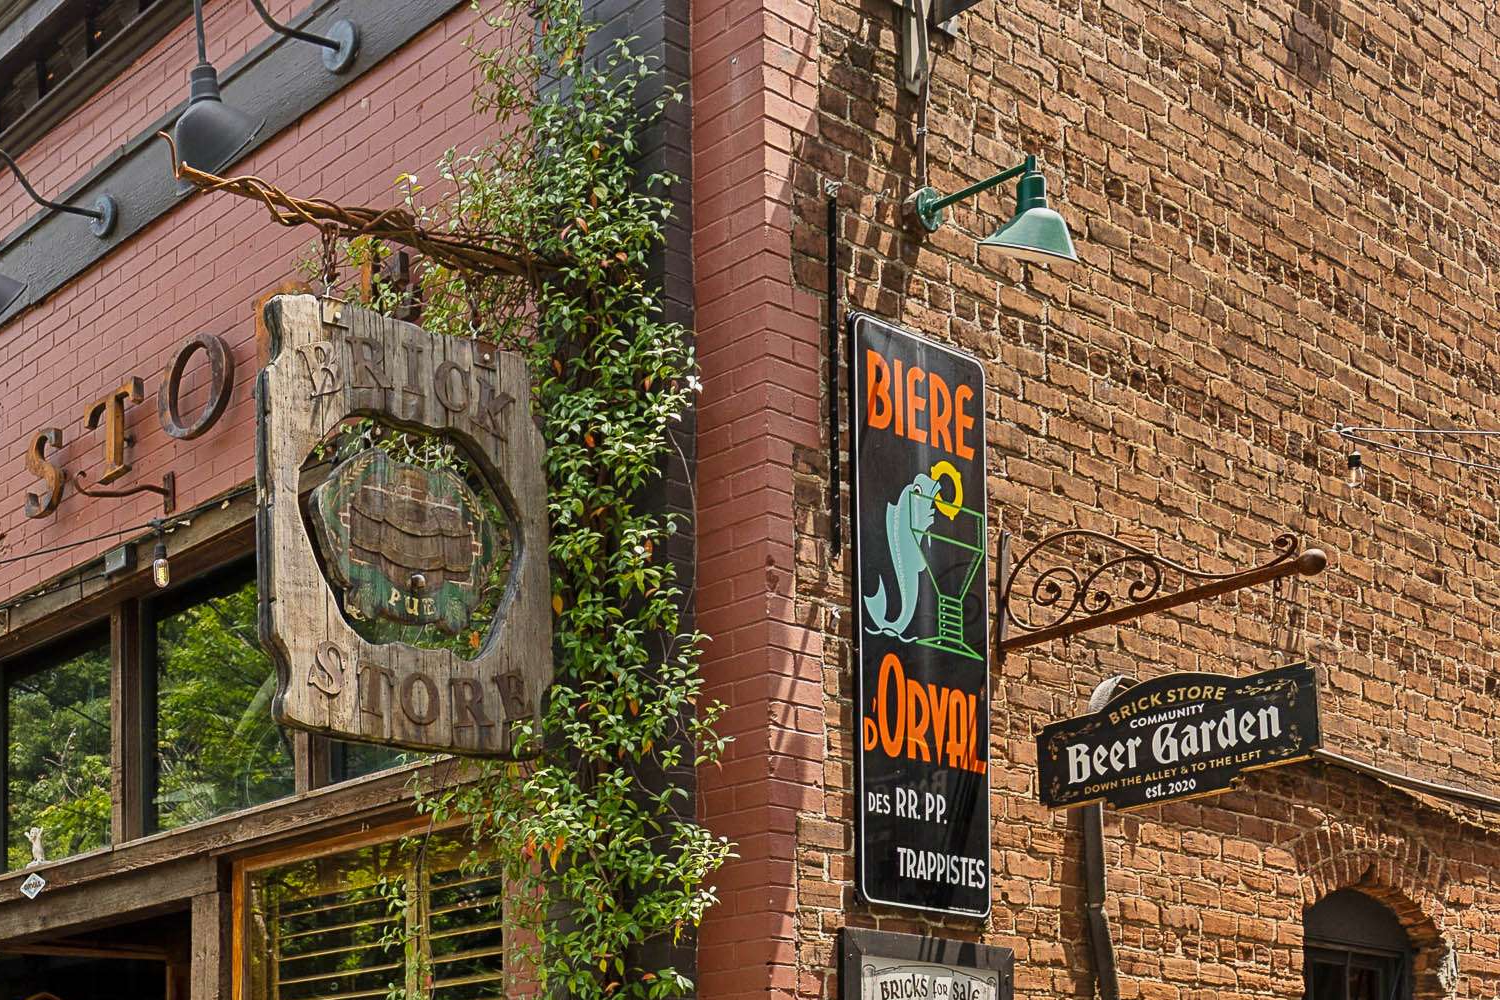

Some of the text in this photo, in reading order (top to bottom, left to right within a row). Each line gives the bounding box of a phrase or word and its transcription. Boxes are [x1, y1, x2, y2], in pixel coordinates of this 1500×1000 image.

[296, 335, 516, 443] BRICK
[867, 349, 976, 461] BIERE
[308, 640, 536, 729] STORE
[1108, 685, 1227, 726] BRICK STORE
[1129, 703, 1205, 729] COMMUNITY
[1066, 705, 1282, 785] Beer Garden
[1084, 750, 1262, 796] DOWN THE ALLEY & TO THE LEFT
[1168, 778, 1197, 794] 2020
[868, 787, 948, 825] DES RR. PP.
[896, 846, 986, 889] TRAPPISTES
[880, 974, 928, 1000] BRICKS
